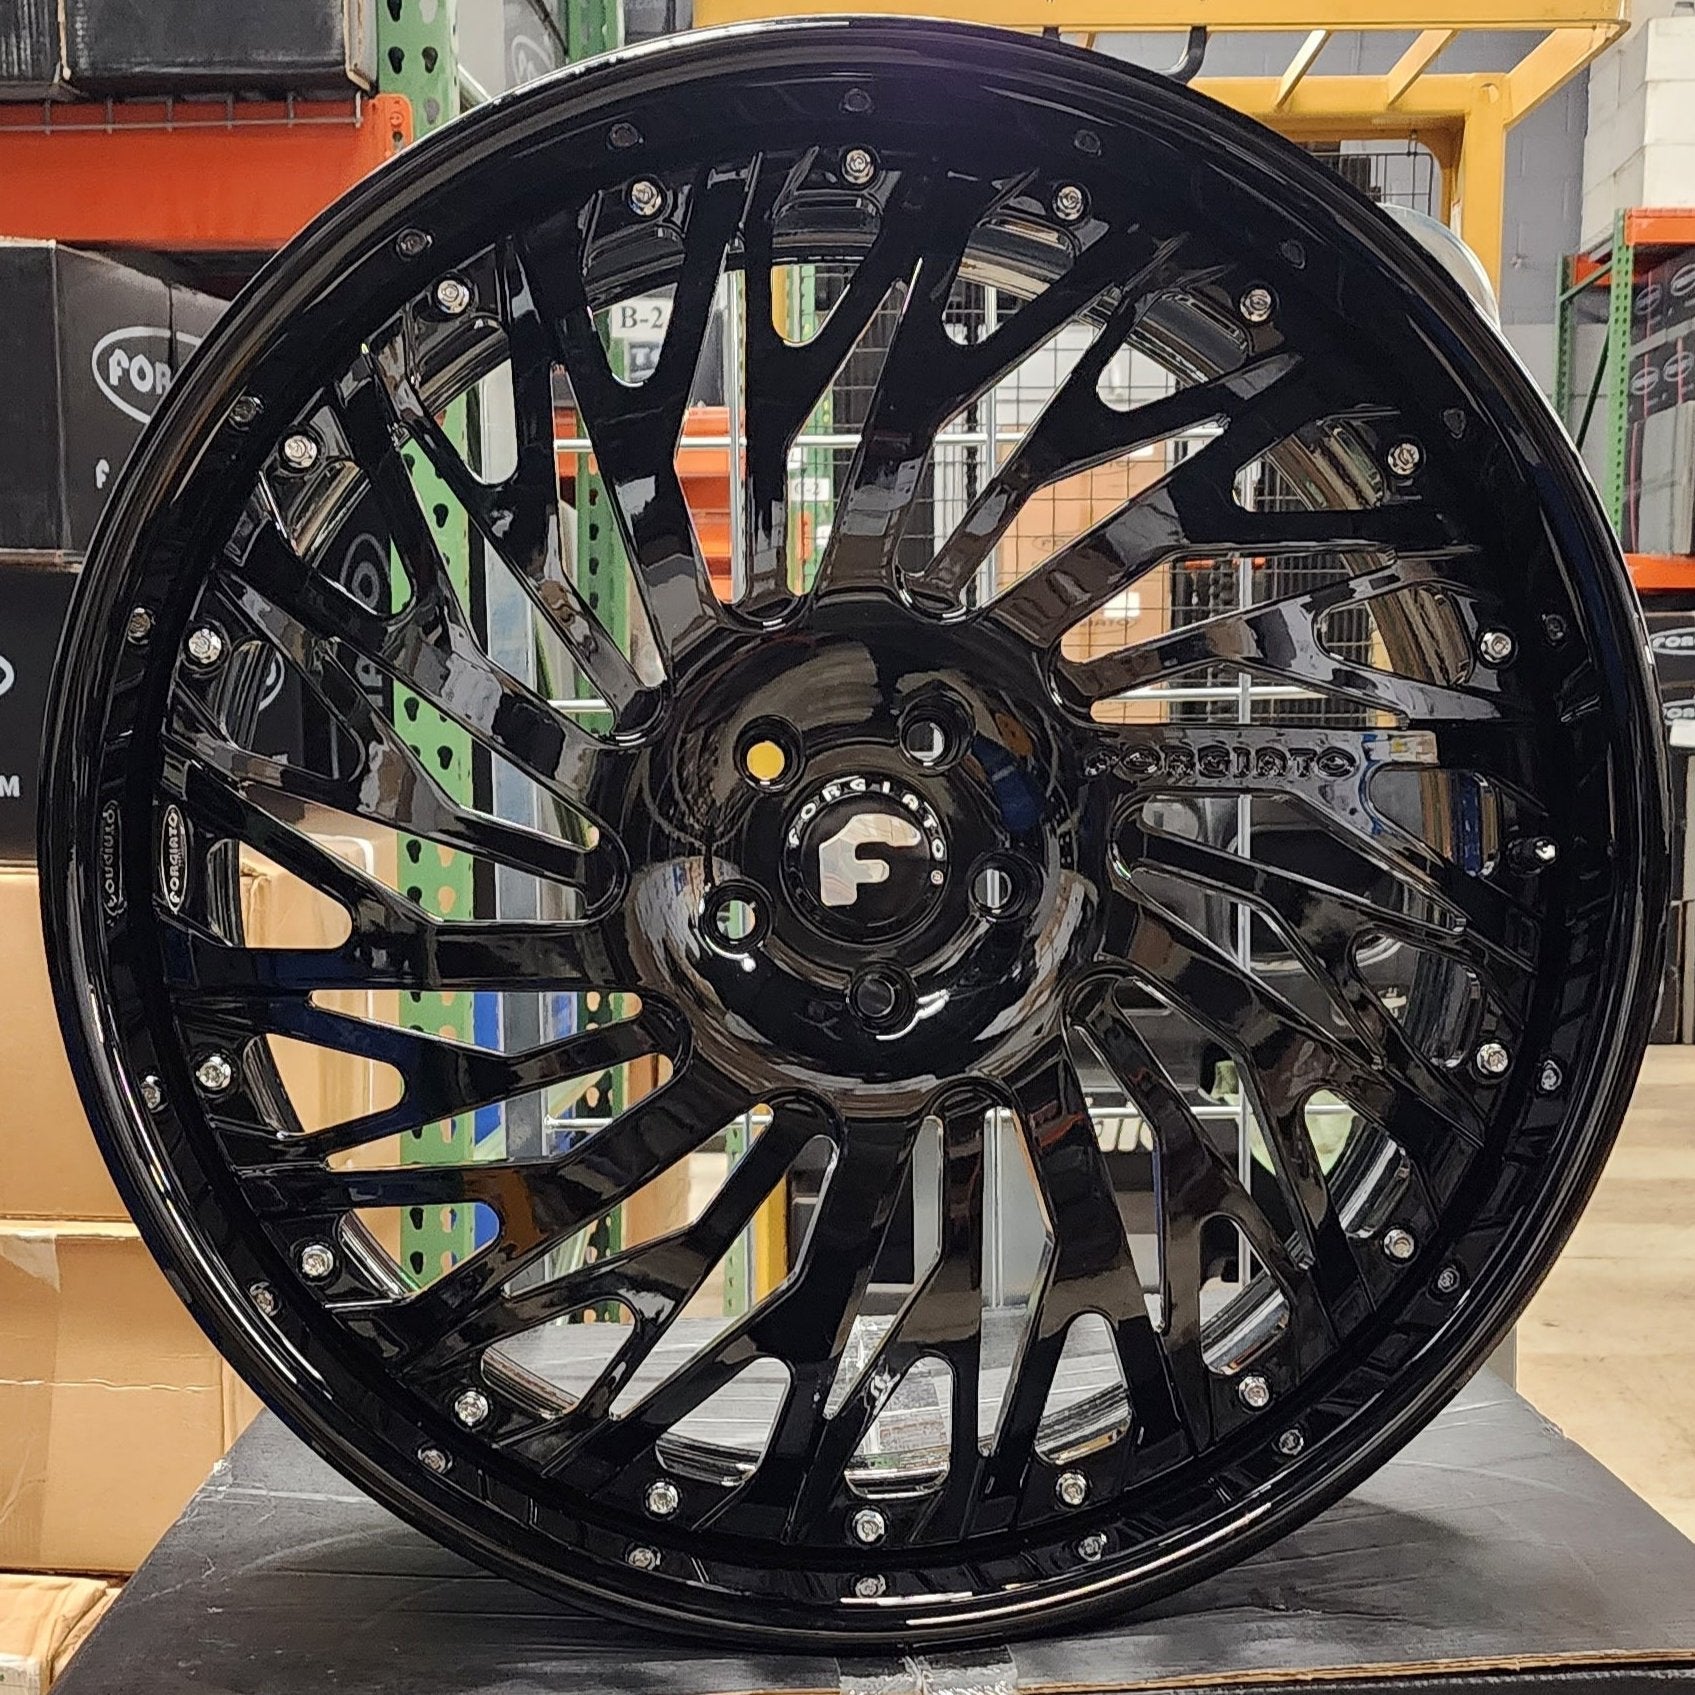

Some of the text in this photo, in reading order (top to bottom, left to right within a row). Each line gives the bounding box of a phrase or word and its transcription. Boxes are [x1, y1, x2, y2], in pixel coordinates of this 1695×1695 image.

[620, 305, 664, 329] B-2
[167, 812, 181, 904] FORGIATO
[788, 777, 946, 864] FORGIATO
